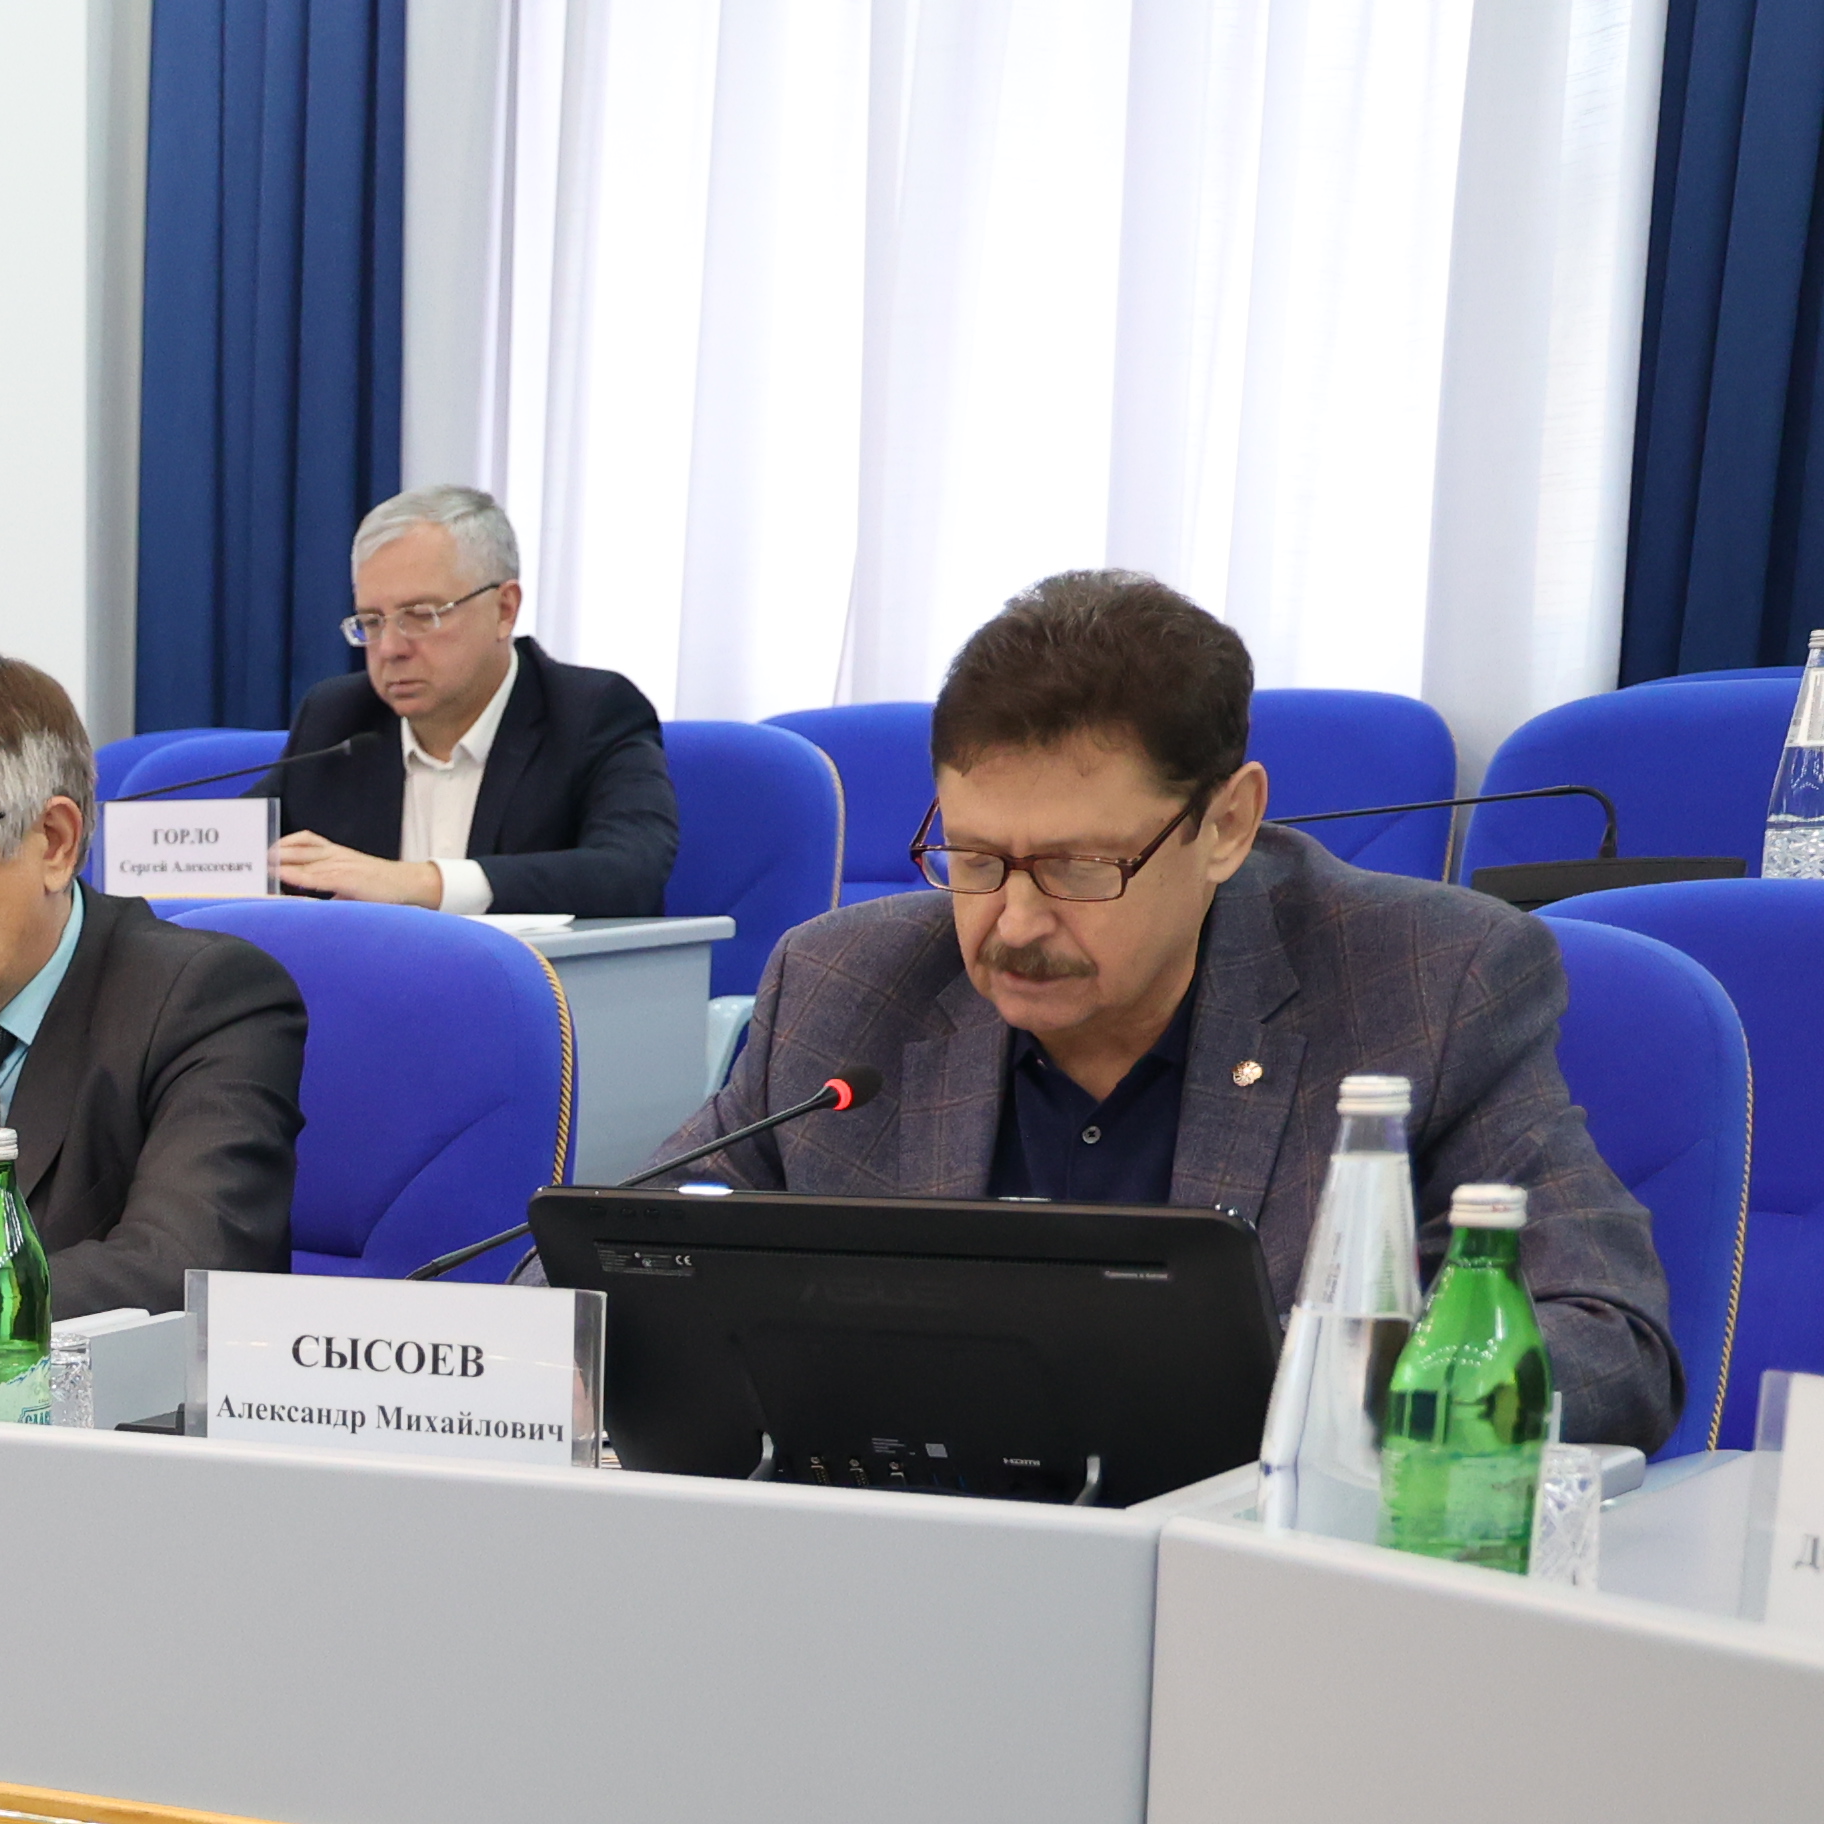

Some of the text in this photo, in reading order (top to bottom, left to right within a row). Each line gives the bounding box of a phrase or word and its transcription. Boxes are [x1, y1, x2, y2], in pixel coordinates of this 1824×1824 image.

[152, 828, 219, 845] ГОРЛО
[119, 860, 253, 876] Сергей Алексеевич
[291, 1334, 485, 1378] СЫСОЕВ
[216, 1394, 565, 1443] Александр Михайлович
